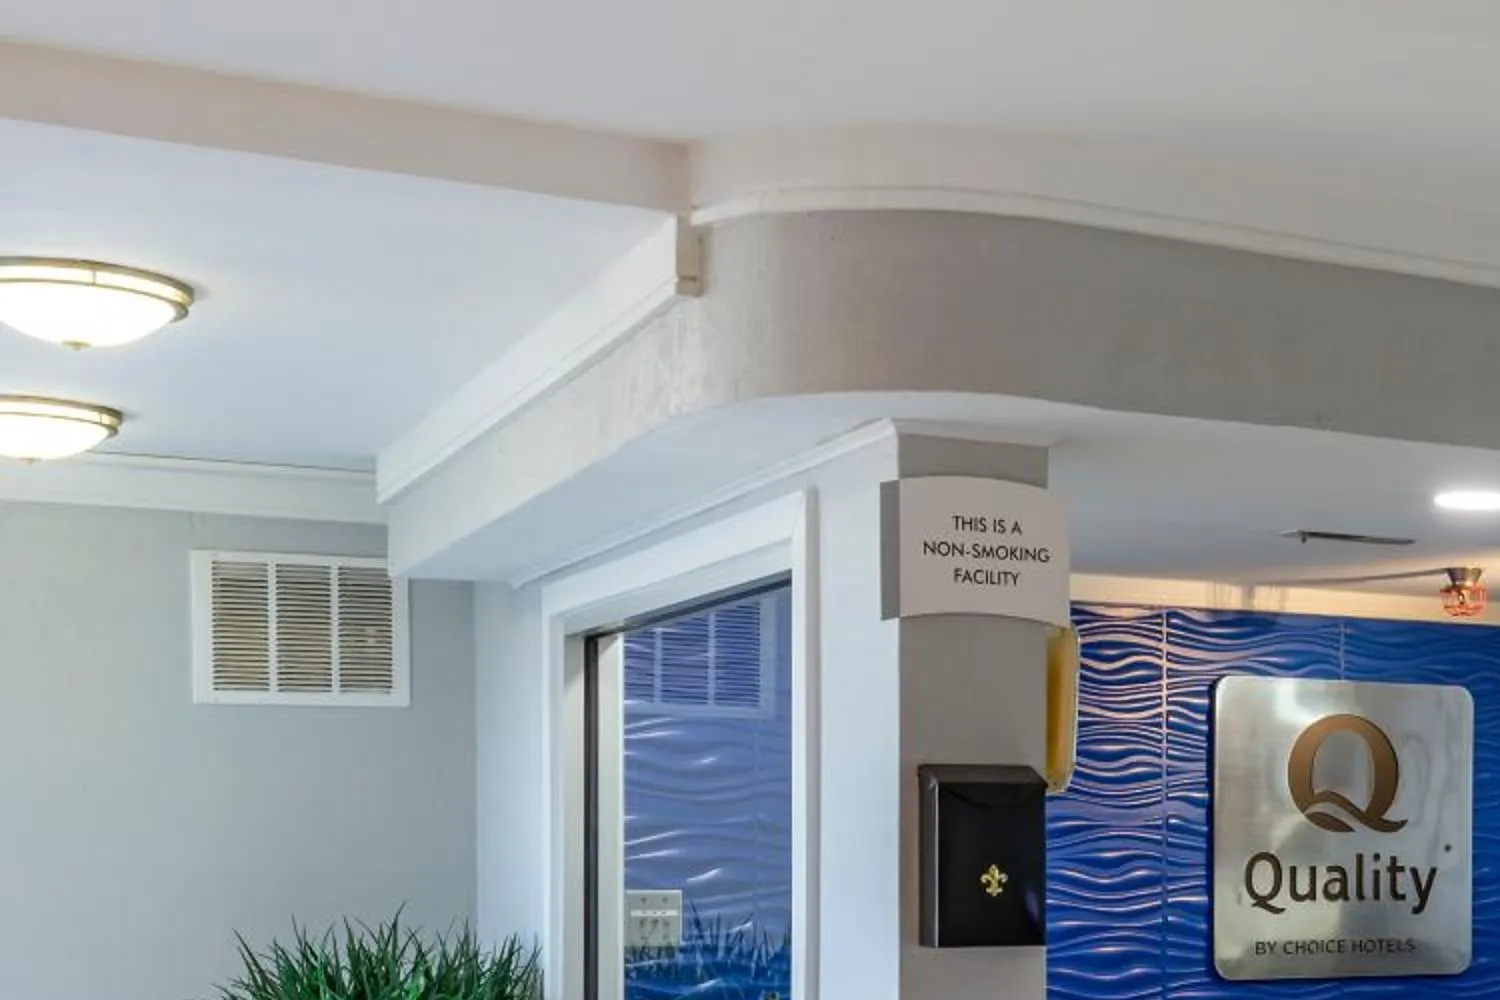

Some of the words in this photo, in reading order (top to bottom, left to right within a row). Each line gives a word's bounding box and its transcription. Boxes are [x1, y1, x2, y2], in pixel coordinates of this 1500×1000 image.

[953, 515, 987, 533] THIS
[993, 519, 1006, 535] IS
[1011, 521, 1023, 535] A
[923, 541, 1051, 564] NON-SMOKING
[953, 568, 1020, 587] FACILITY
[1287, 713, 1408, 833] Q
[1245, 851, 1437, 914] Quality
[1255, 940, 1277, 956] BY
[1283, 939, 1346, 955] CHOICE
[1352, 938, 1417, 954] HOTELS
